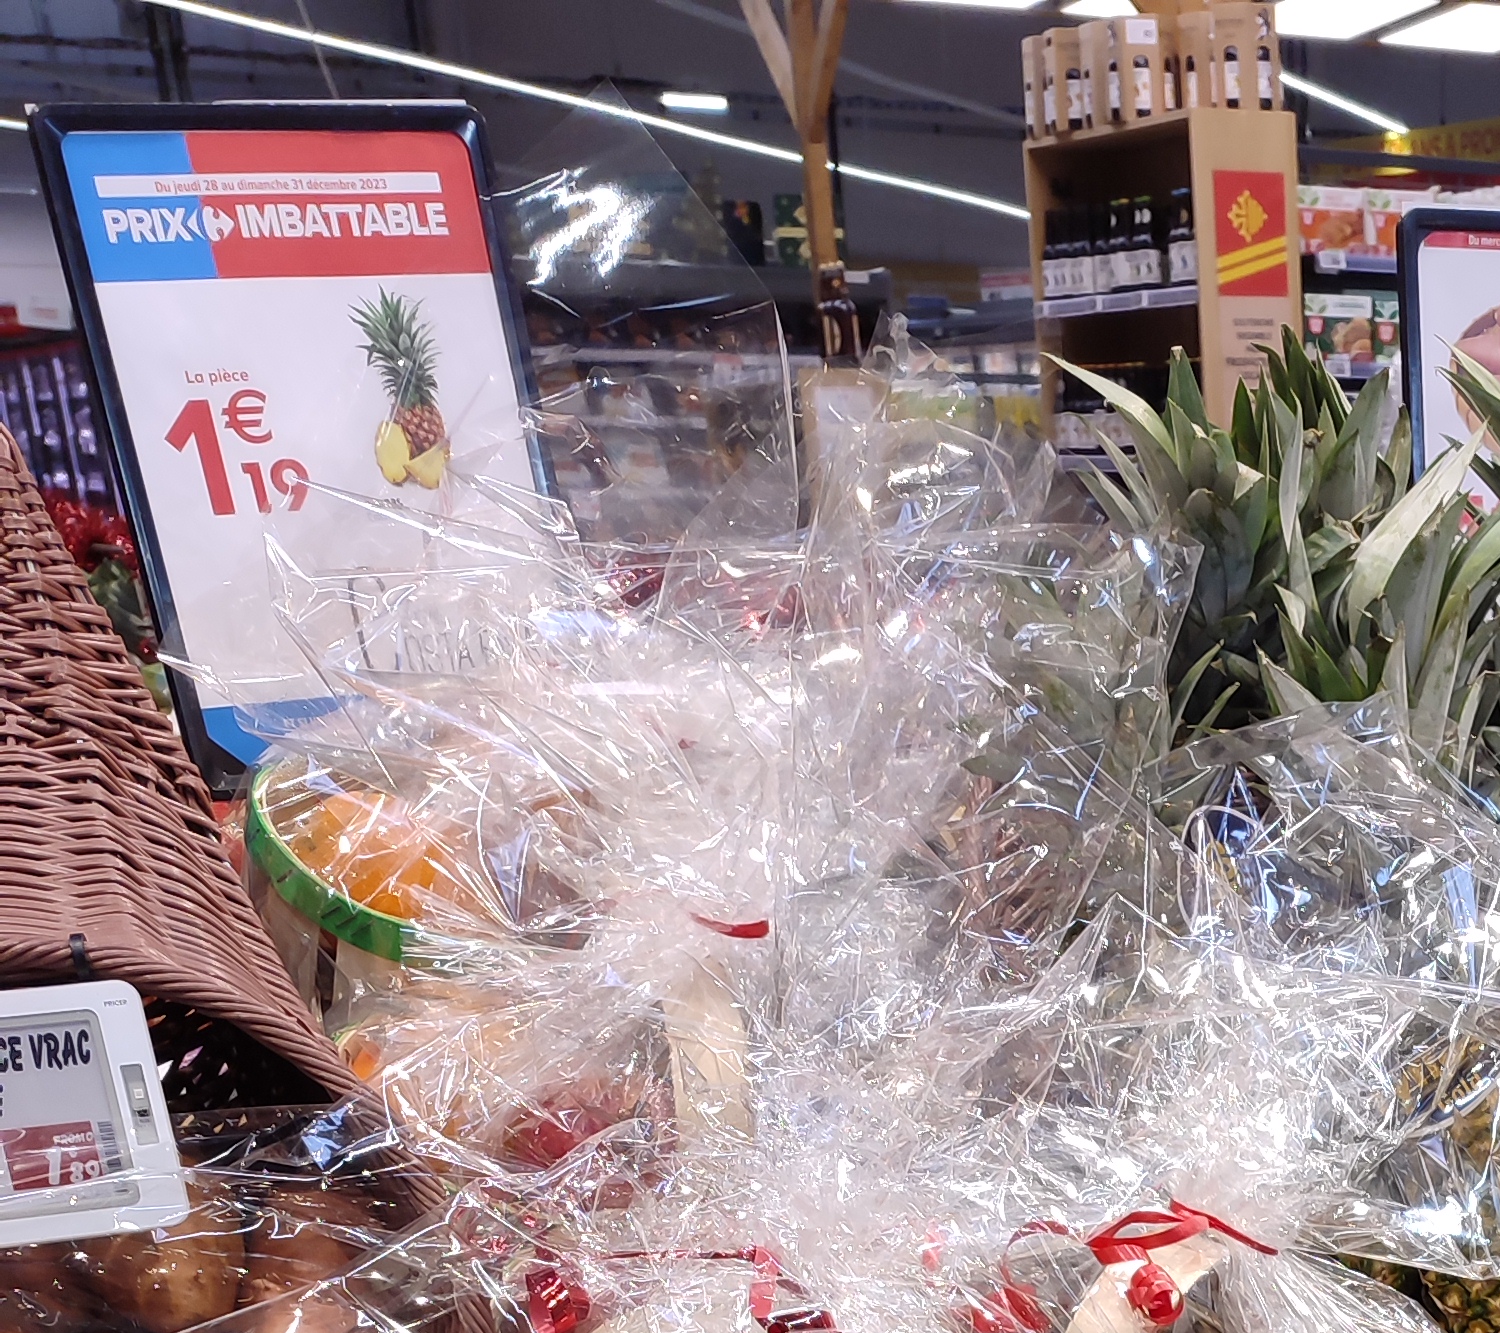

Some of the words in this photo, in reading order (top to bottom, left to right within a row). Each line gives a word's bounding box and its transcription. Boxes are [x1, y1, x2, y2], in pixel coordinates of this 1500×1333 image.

[154, 180, 171, 193] Du
[173, 179, 201, 196] jeudi
[203, 179, 219, 191] 28
[221, 181, 234, 192] au
[237, 178, 289, 192] dimanche
[291, 178, 304, 190] 31
[305, 177, 357, 191] décembre
[359, 178, 388, 190] 2023
[102, 206, 195, 244] PRIX
[234, 202, 450, 238] IMBATTABLE
[1468, 234, 1480, 246] Du
[184, 370, 204, 384] La
[208, 368, 249, 386] pièce
[28, 1029, 91, 1071] VRAC
[53, 1131, 93, 1146] PROMO
